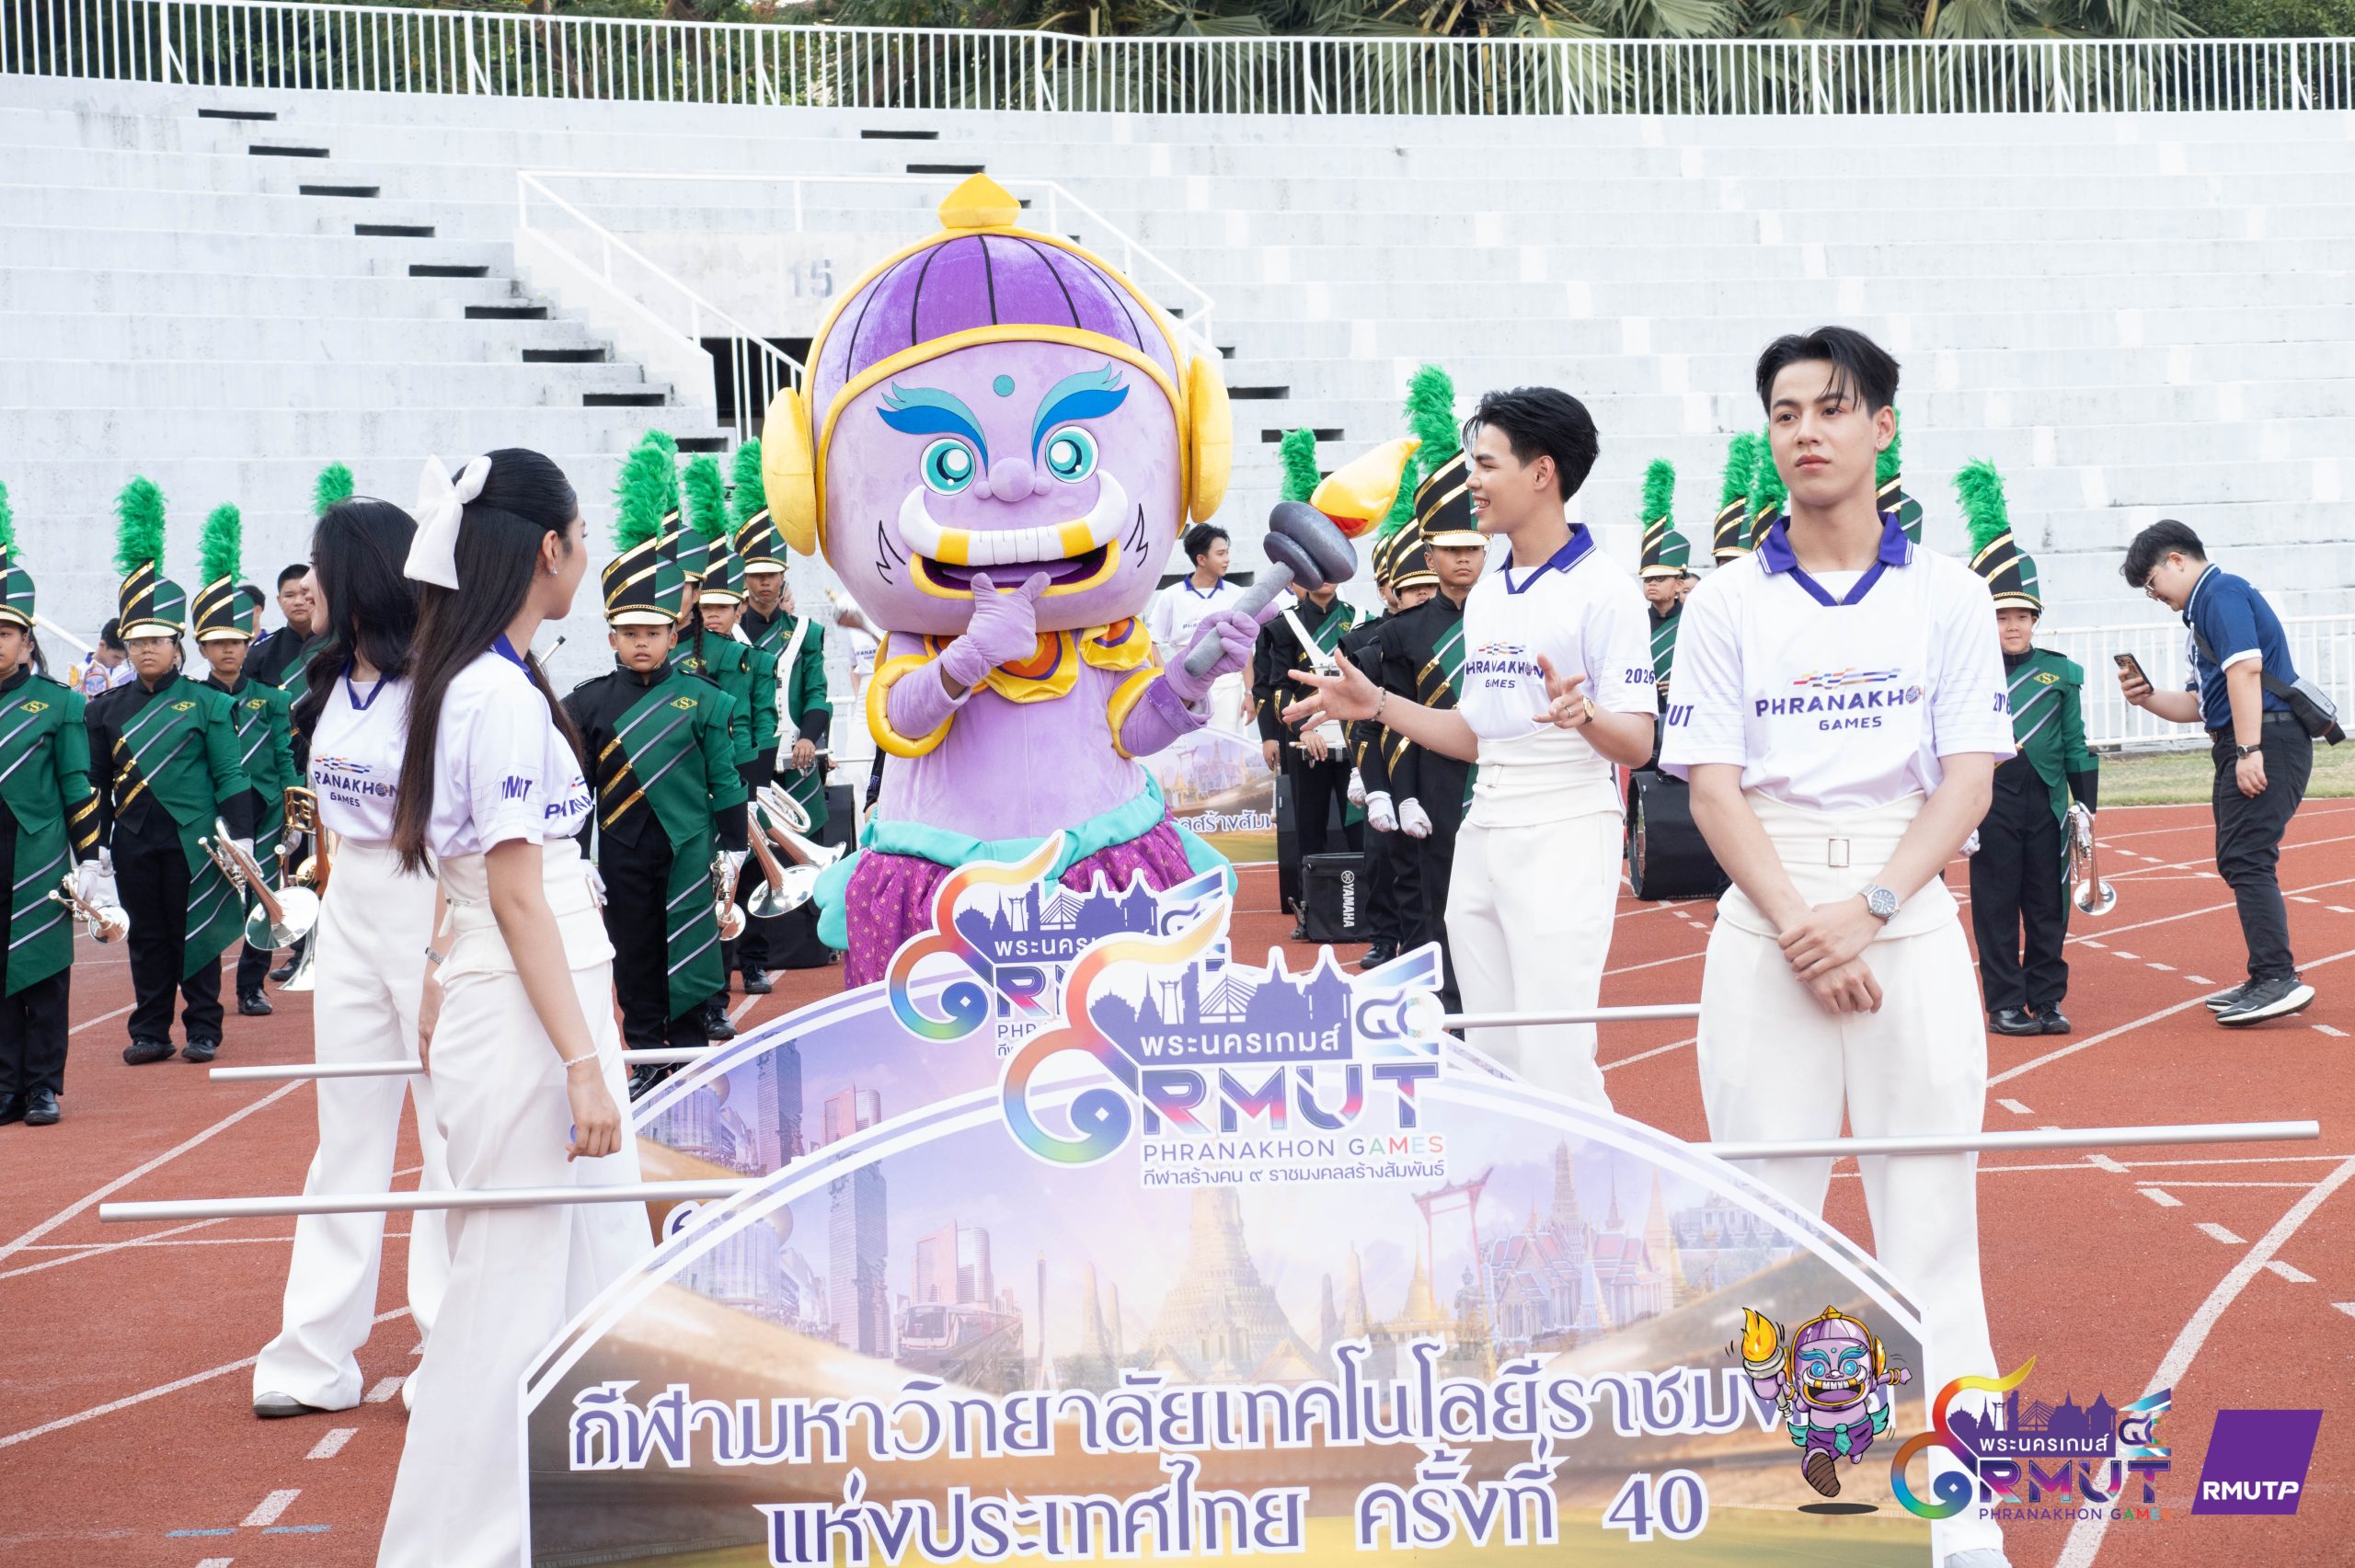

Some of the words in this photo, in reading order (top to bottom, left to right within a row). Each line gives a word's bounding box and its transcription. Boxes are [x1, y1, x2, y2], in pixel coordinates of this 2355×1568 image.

[788, 260, 833, 298] 15
[1486, 679, 1516, 688] GMES
[1625, 669, 1655, 684] 2026
[1755, 685, 1924, 717] PHRANAKHO
[1666, 704, 1694, 727] UT
[1819, 715, 1882, 731] GAMES
[330, 792, 361, 807] GAMES
[1342, 883, 1355, 928] YAMAHA
[994, 936, 1098, 957] พระนคร
[1141, 1023, 1342, 1057] พระนครเกมส์
[1143, 1062, 1439, 1136] RMUT
[1143, 1139, 1335, 1162] PHRANAKHON
[1349, 1135, 1443, 1156] GAMES
[1143, 1166, 1243, 1185] กีฬาสร้างคน
[1269, 1160, 1445, 1182] ราชมงคลสร้างสัมพันธ์
[576, 1343, 1890, 1464] กีฬามหาวิทยาลัยเทคโนโลยีราชมง
[771, 1459, 1299, 1563] แห่งประเทศไทย
[1361, 1435, 1552, 1544] ครั้งที่
[1608, 1475, 1703, 1535] 40
